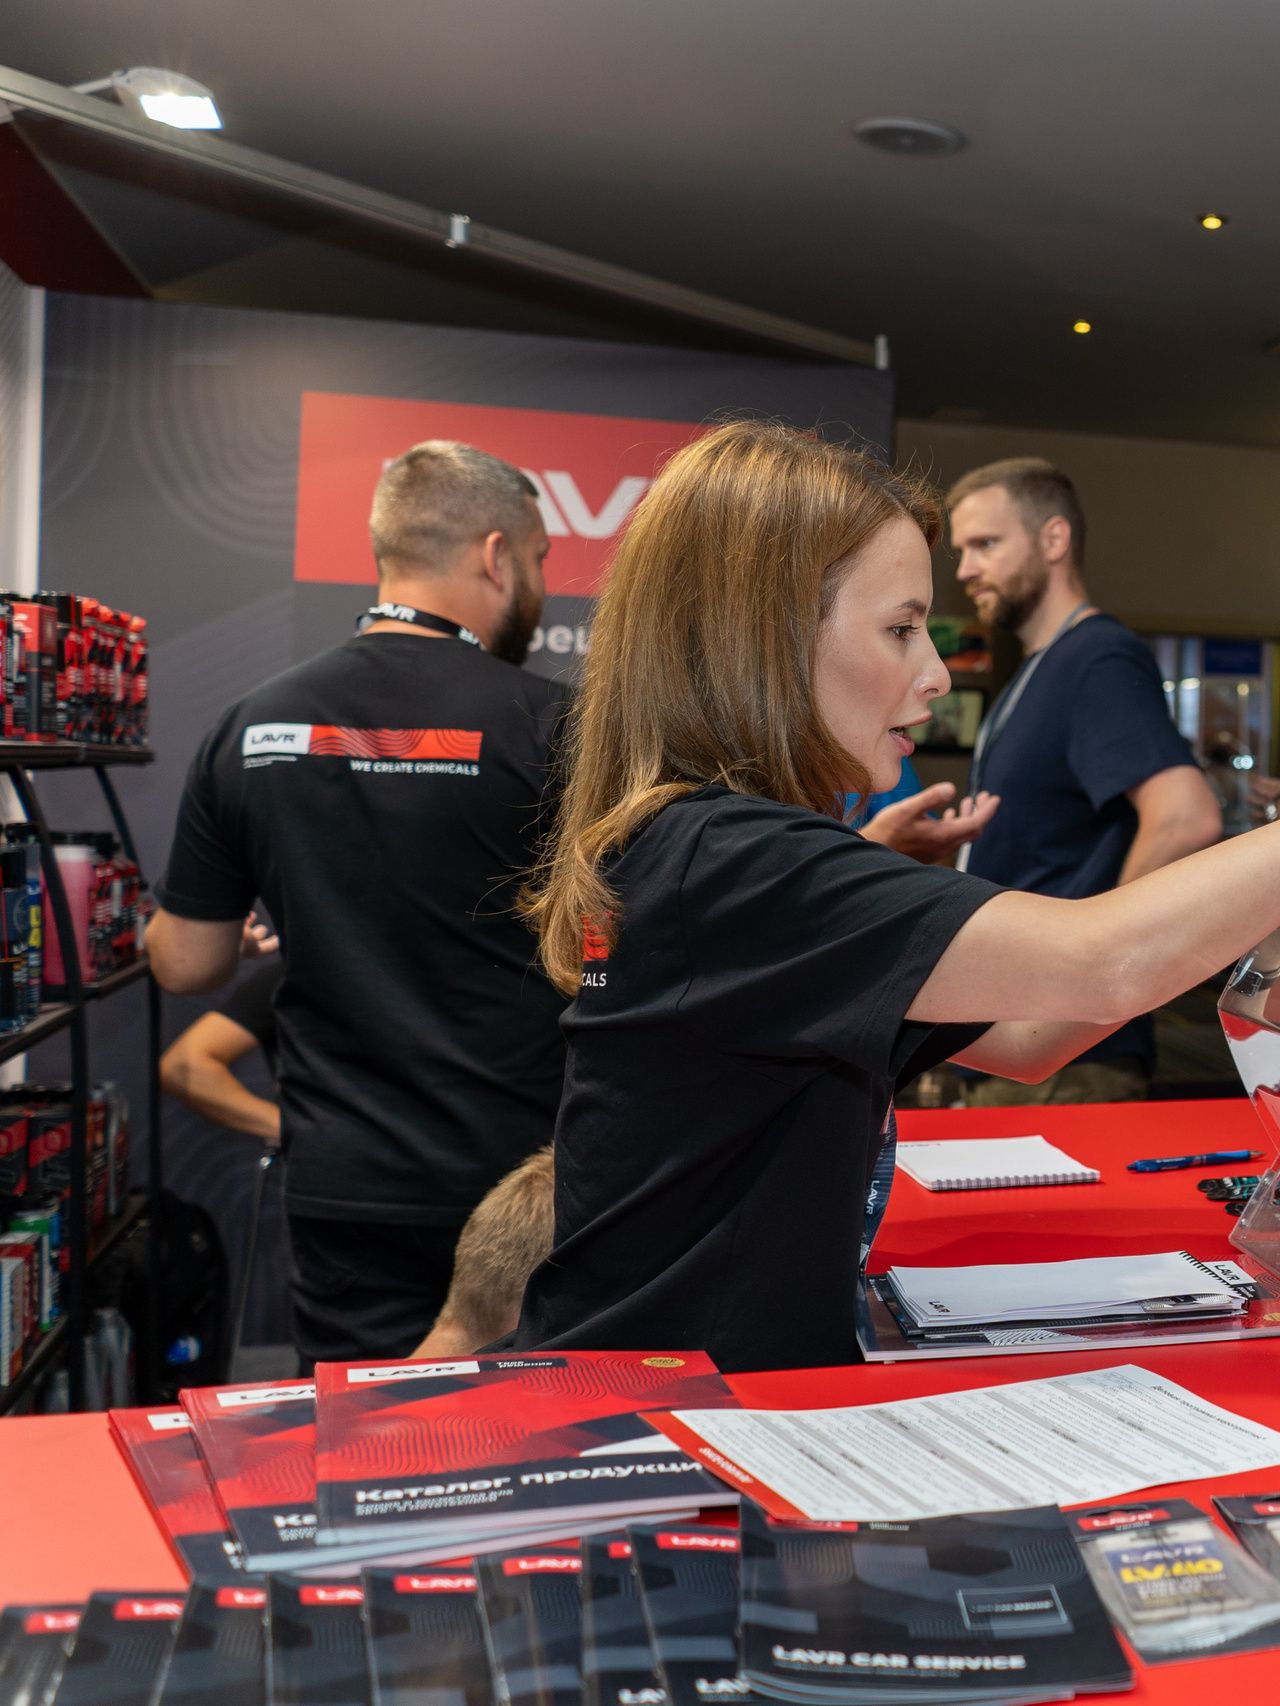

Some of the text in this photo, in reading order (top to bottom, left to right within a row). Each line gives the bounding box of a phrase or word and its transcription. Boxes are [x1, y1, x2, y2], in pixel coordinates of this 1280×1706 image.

[251, 733, 295, 745] LAVR
[350, 760, 480, 776] WE CREATE CHEMICALS
[866, 1180, 880, 1215] LAVR
[1214, 1264, 1241, 1281] LAVR
[368, 1366, 457, 1377] LAVR
[355, 1476, 511, 1503] Каталог
[520, 1461, 704, 1486] продукци
[772, 1644, 846, 1666] LAVR
[851, 1651, 909, 1668] CAR
[912, 1654, 1027, 1671] SERVICE
